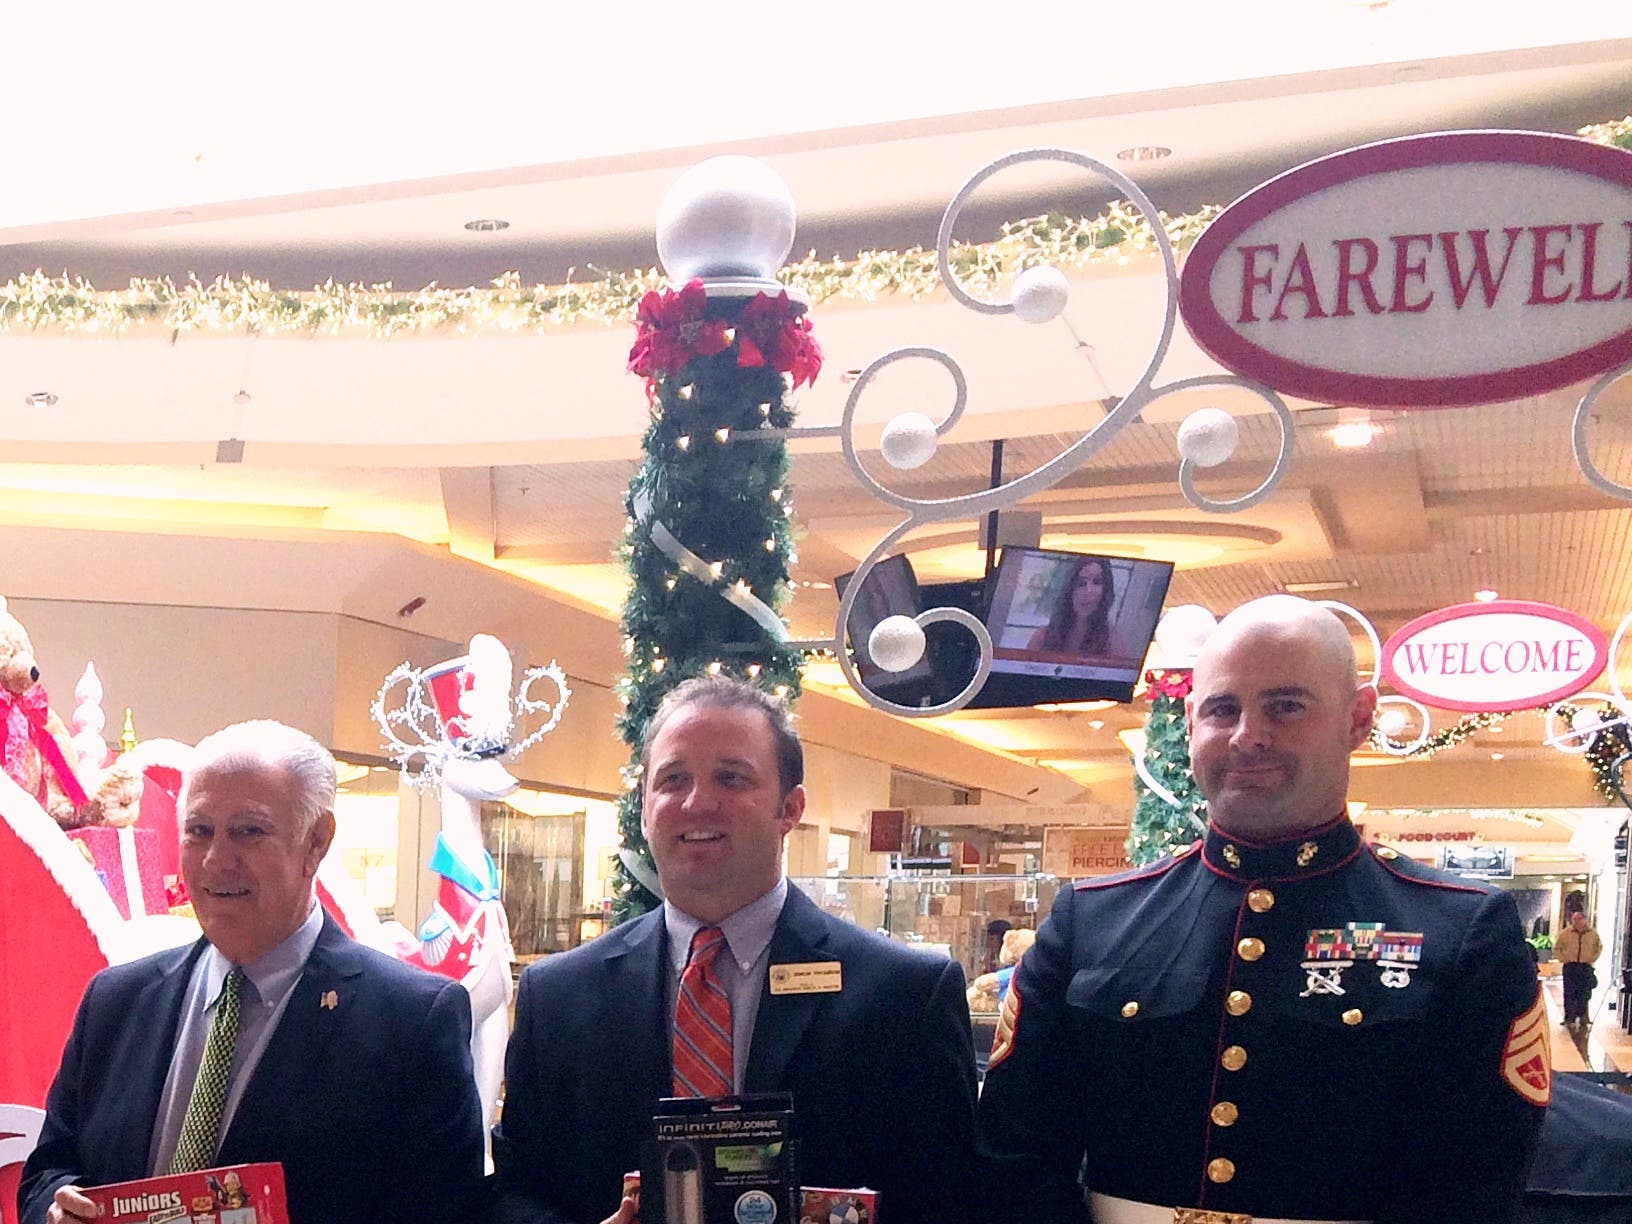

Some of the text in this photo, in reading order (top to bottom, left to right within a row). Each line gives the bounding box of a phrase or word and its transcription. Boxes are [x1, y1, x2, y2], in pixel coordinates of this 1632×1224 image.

[1235, 220, 1632, 326] FAREWEL
[1404, 639, 1584, 675] WELCOME
[1397, 831, 1476, 842] FOOD COURT
[1072, 856, 1132, 868] PIERCIN
